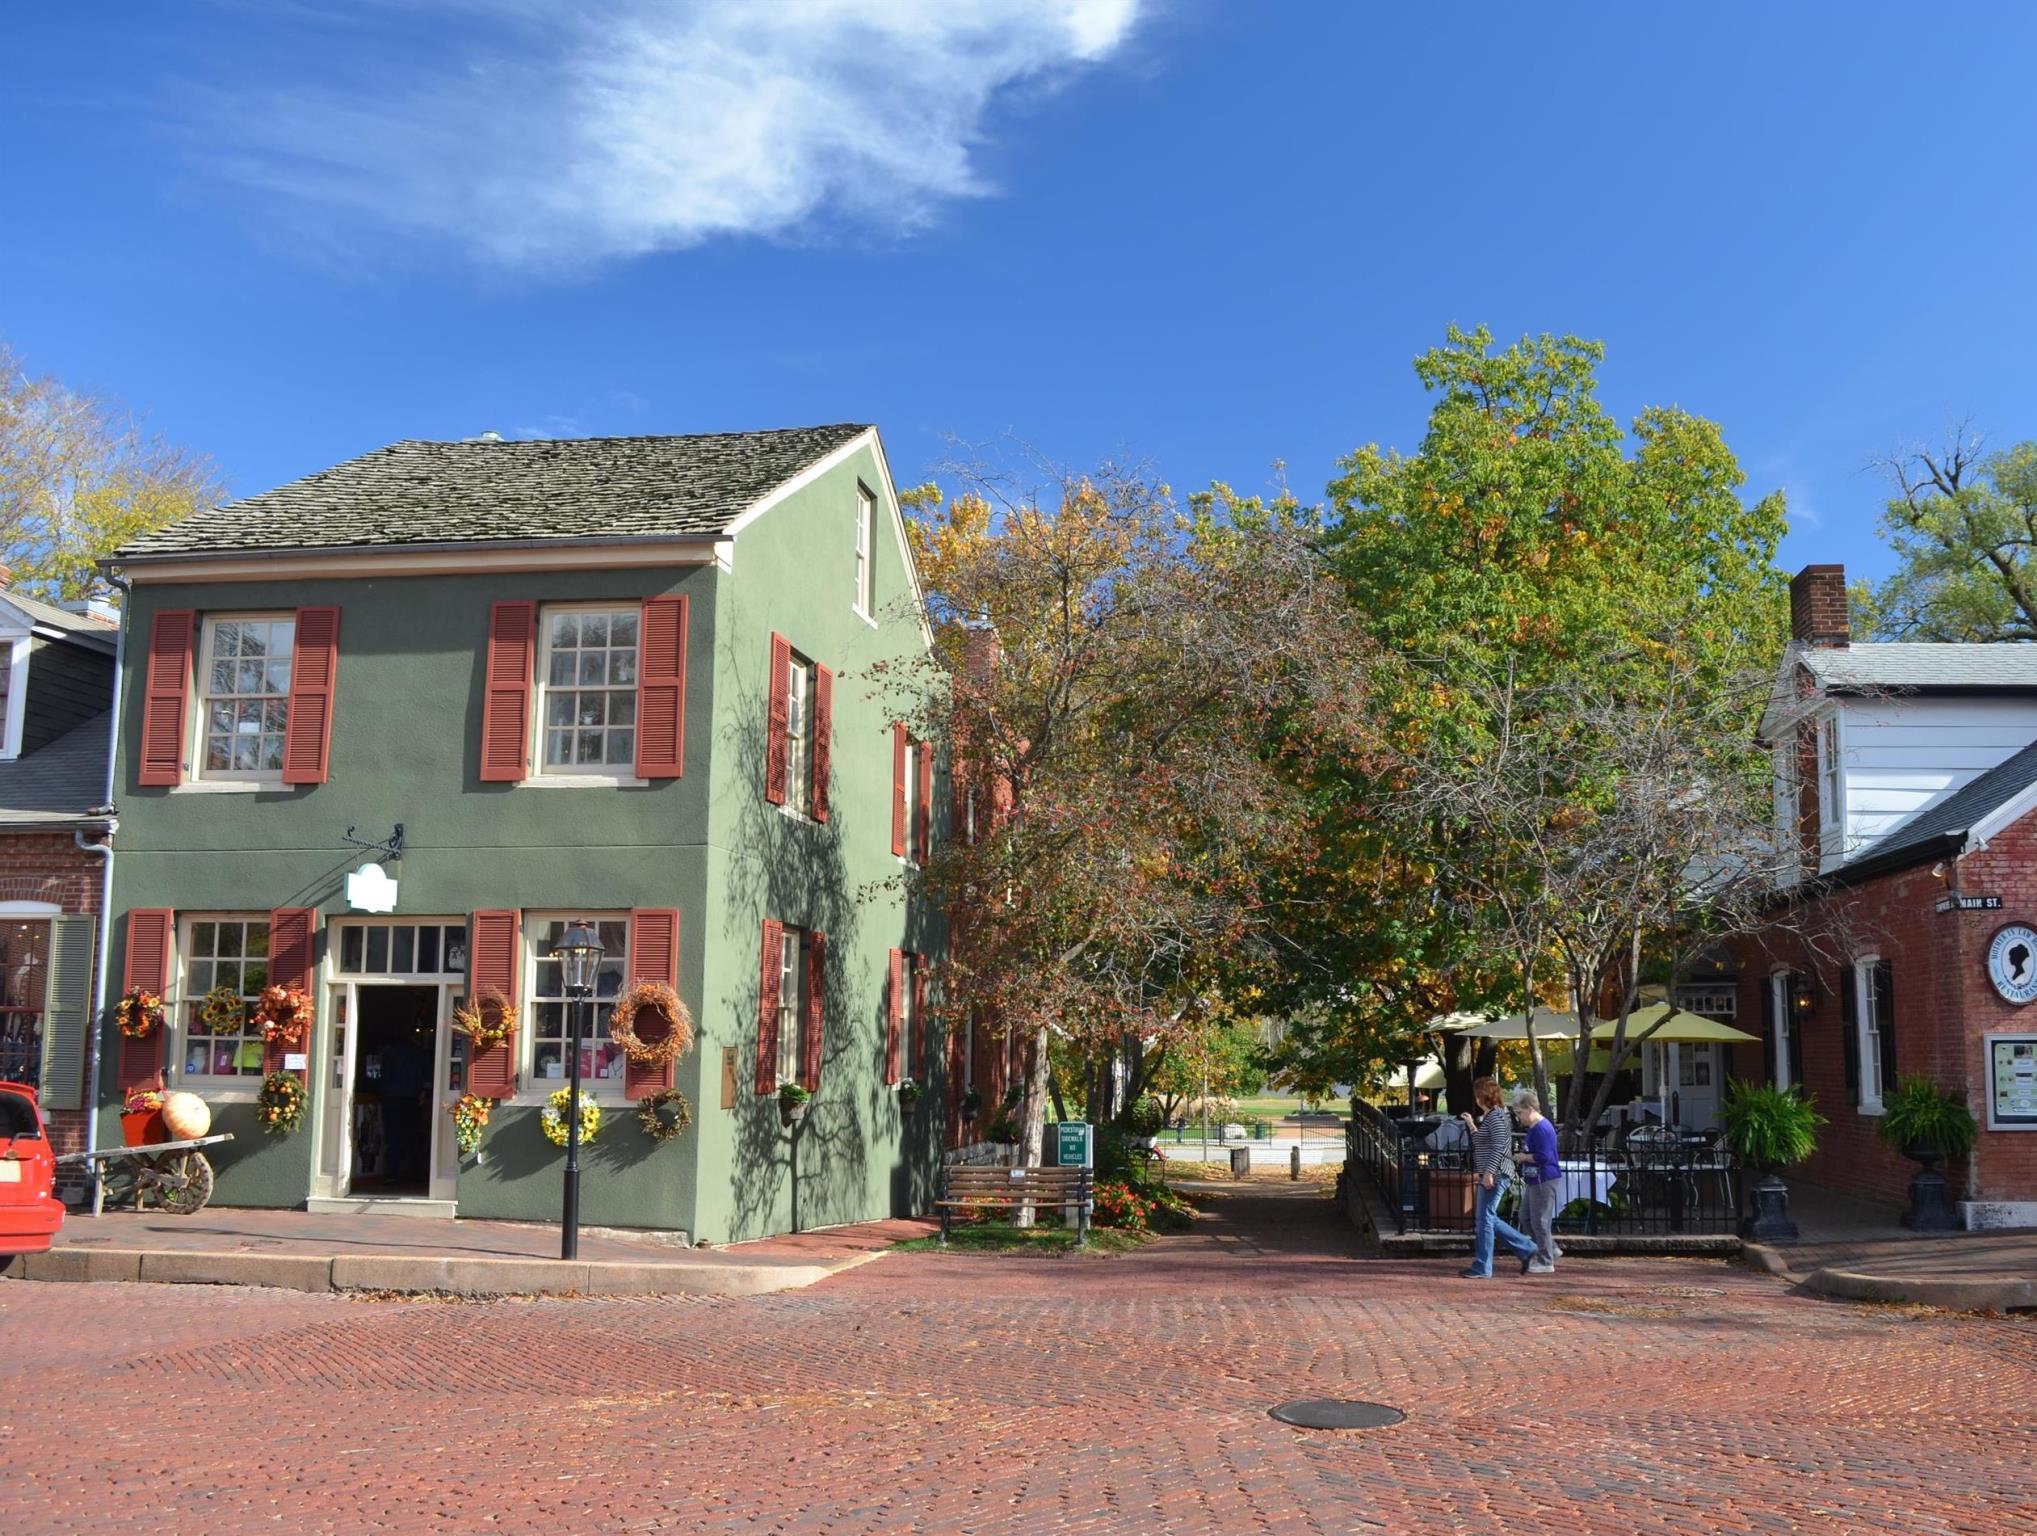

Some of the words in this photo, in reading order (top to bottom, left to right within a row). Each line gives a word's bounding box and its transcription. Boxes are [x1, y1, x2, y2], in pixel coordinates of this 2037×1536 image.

[1959, 899, 1983, 909] MAIN
[1986, 898, 2001, 908] ST.
[1991, 933, 2007, 959] MOTHER
[2017, 928, 2031, 939] LAW
[1997, 980, 2037, 999] RESTAURAN
